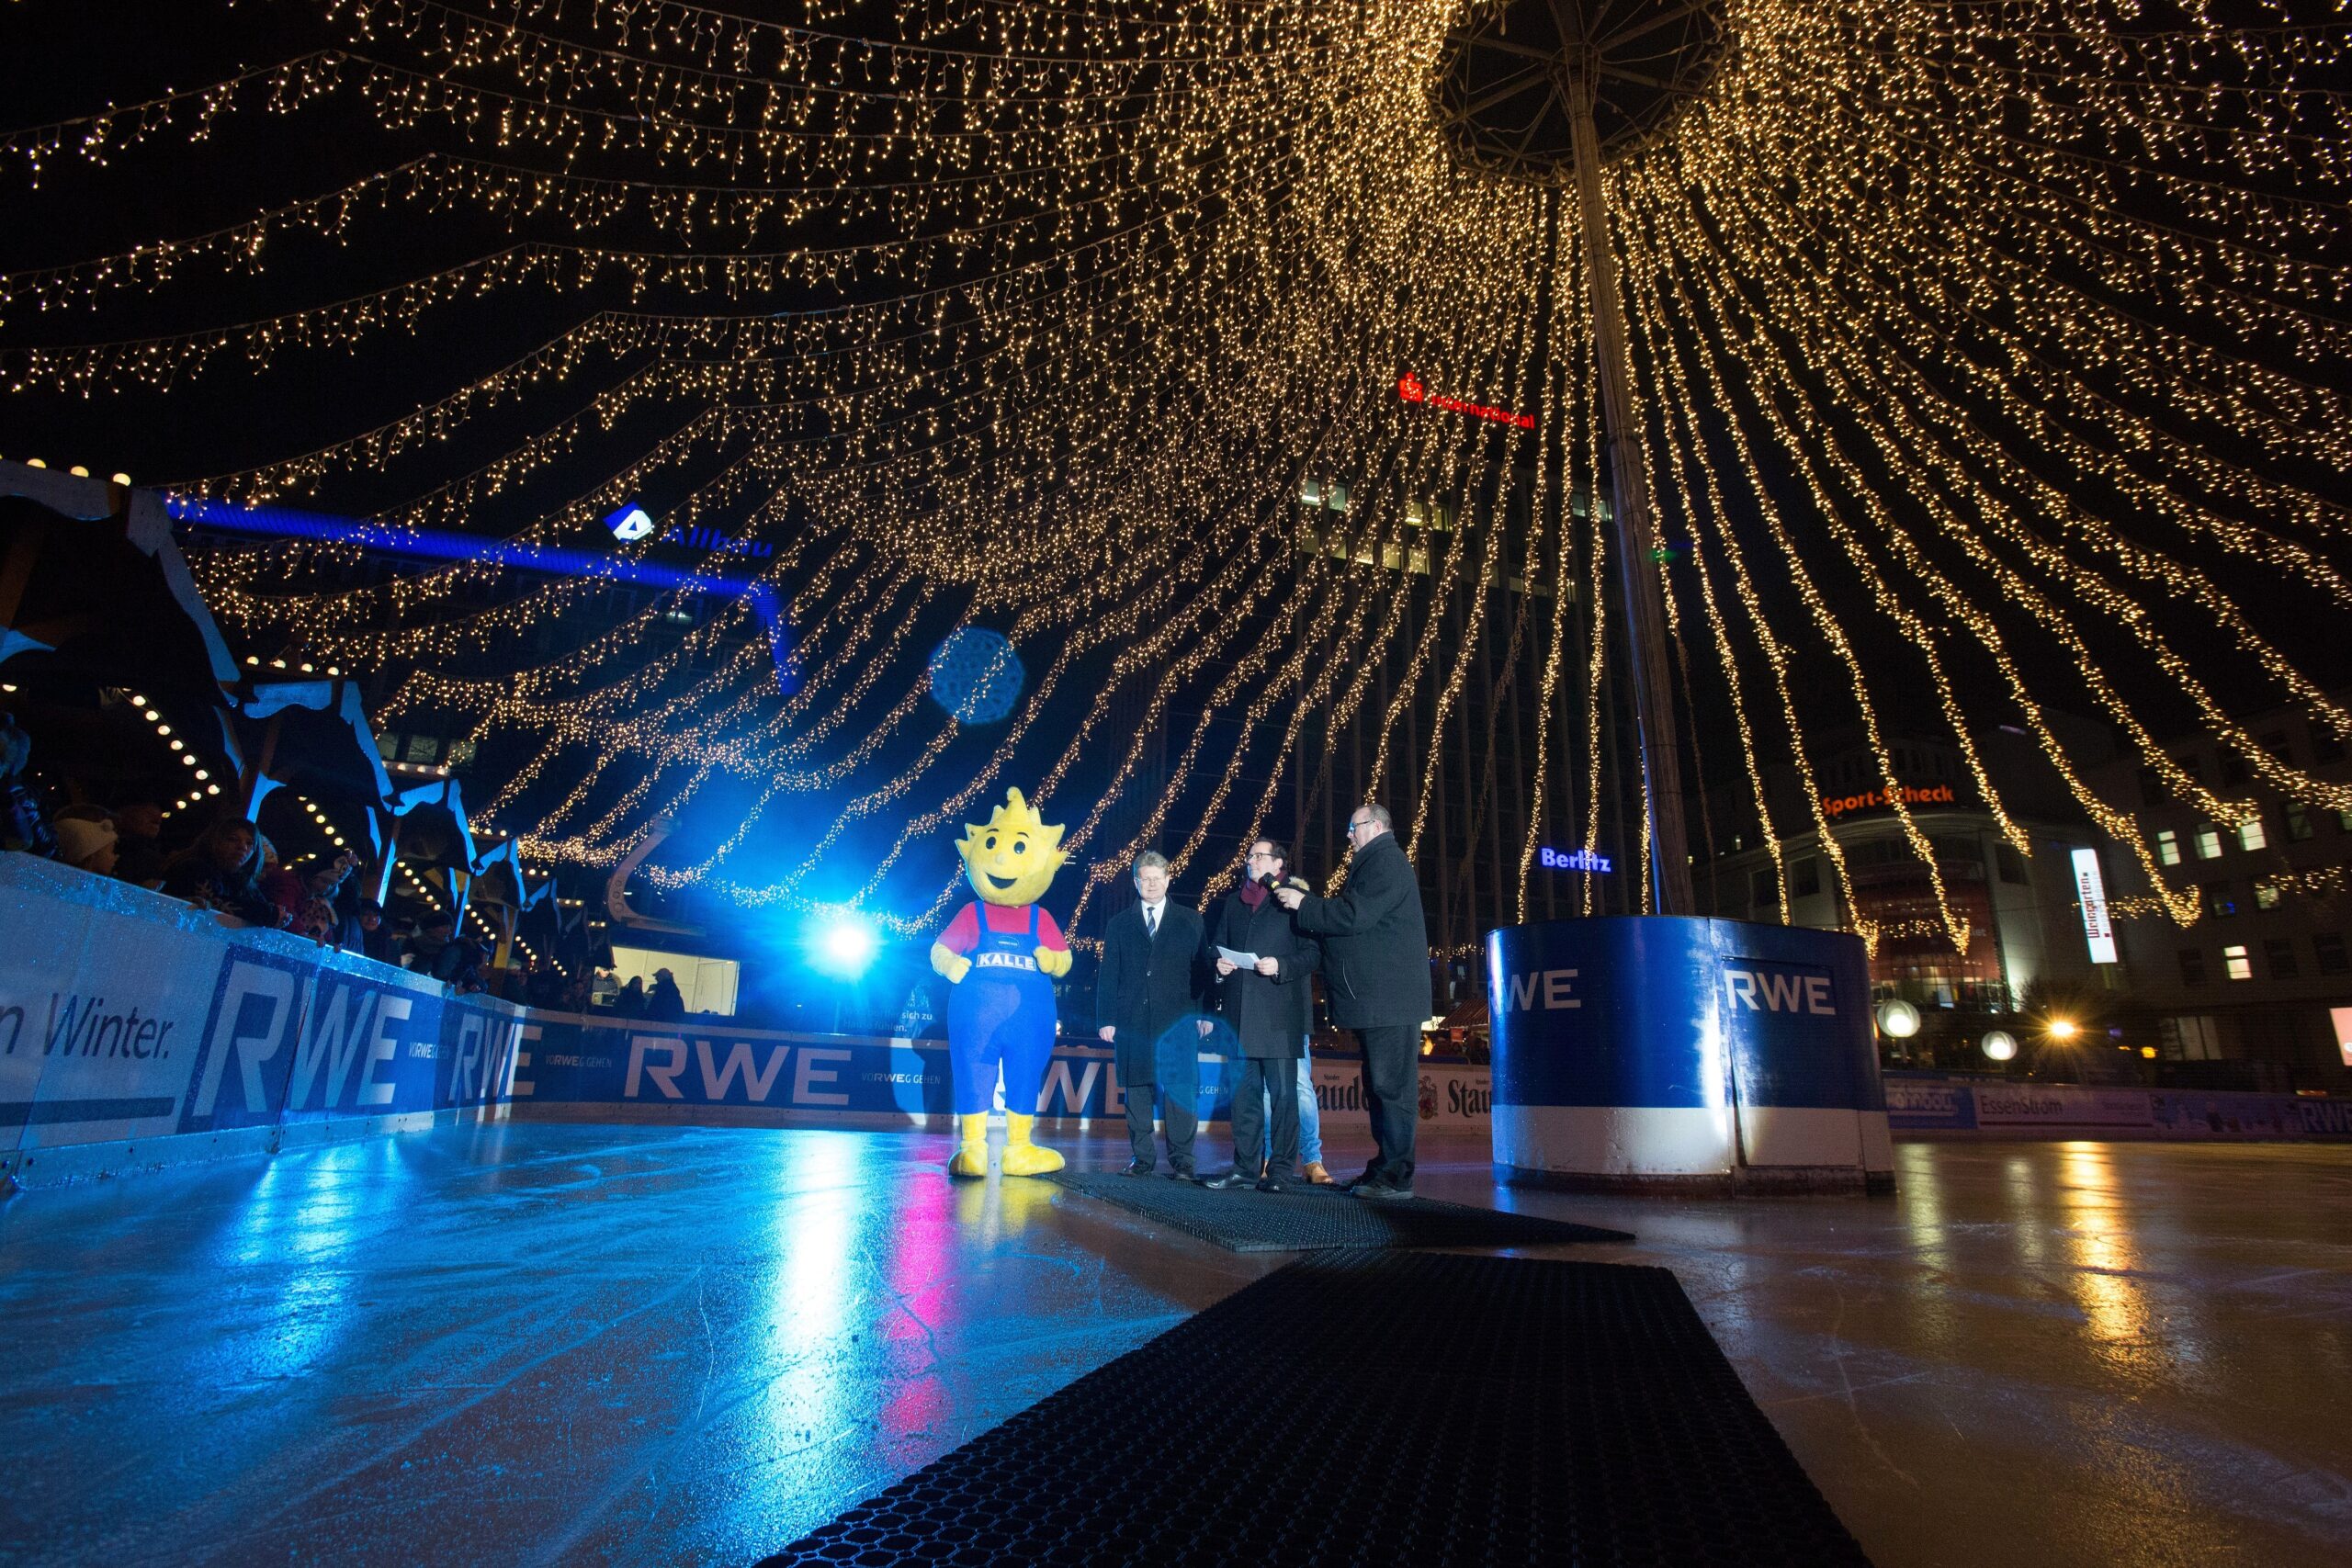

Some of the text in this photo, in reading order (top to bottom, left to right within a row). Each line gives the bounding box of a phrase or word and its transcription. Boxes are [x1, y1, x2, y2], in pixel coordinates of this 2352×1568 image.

[662, 525, 774, 558] Allbau
[1822, 784, 1955, 818] Sport-Scheck
[2080, 877, 2100, 939] Weingarten
[978, 953, 1035, 970] KALLE
[1723, 969, 1836, 1016] RWE
[43, 992, 175, 1059] Winter.
[191, 959, 413, 1117] RWE
[447, 1012, 543, 1101] RWE
[624, 1035, 852, 1106] RWE
[861, 1072, 911, 1084] VORWEG
[1979, 1094, 2064, 1116] EssenStrom
